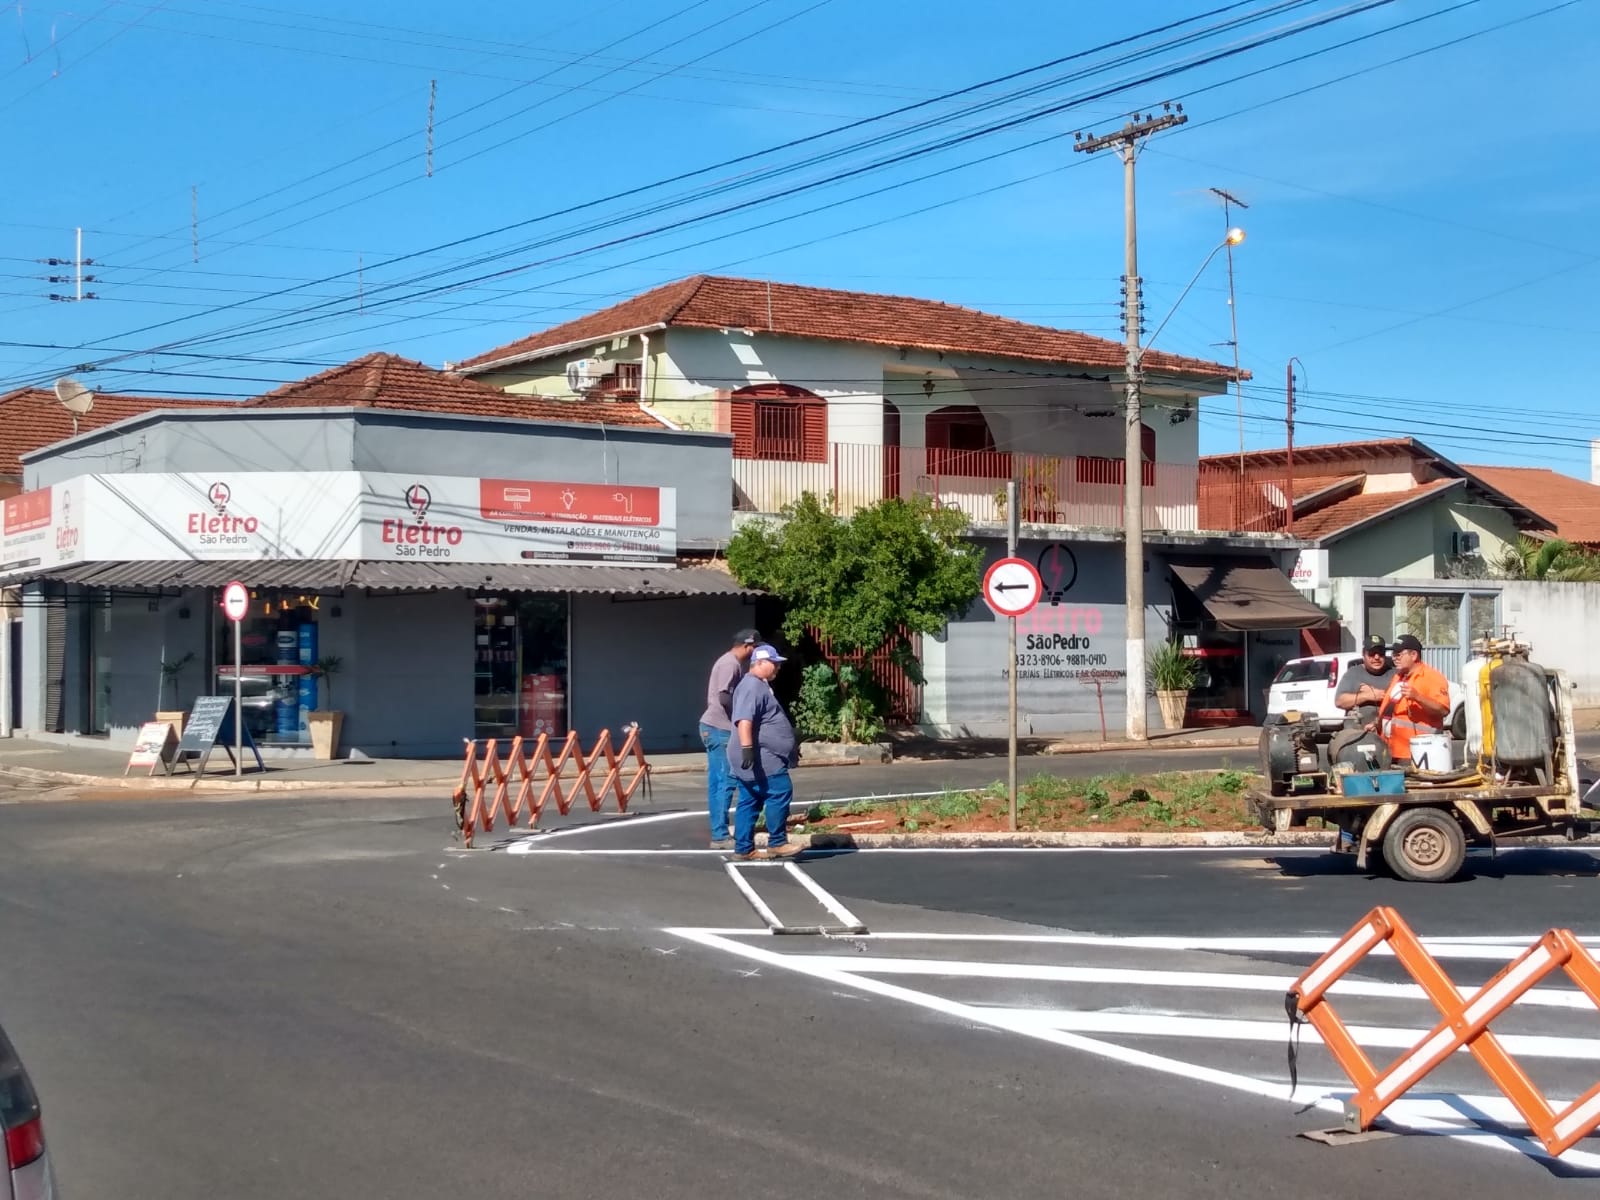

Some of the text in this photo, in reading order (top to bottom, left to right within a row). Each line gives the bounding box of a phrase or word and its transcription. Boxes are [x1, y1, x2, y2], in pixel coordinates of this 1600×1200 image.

[188, 512, 258, 533] Eletro
[382, 517, 463, 545] Eletro
[540, 525, 596, 537] INSTALAÇÕES
[598, 528, 602, 536] E
[603, 528, 661, 540] MANUTENÇÃO
[200, 534, 248, 544] São Pedro
[396, 545, 451, 557] São Pedro
[1001, 668, 1040, 680] MTERIAIS
